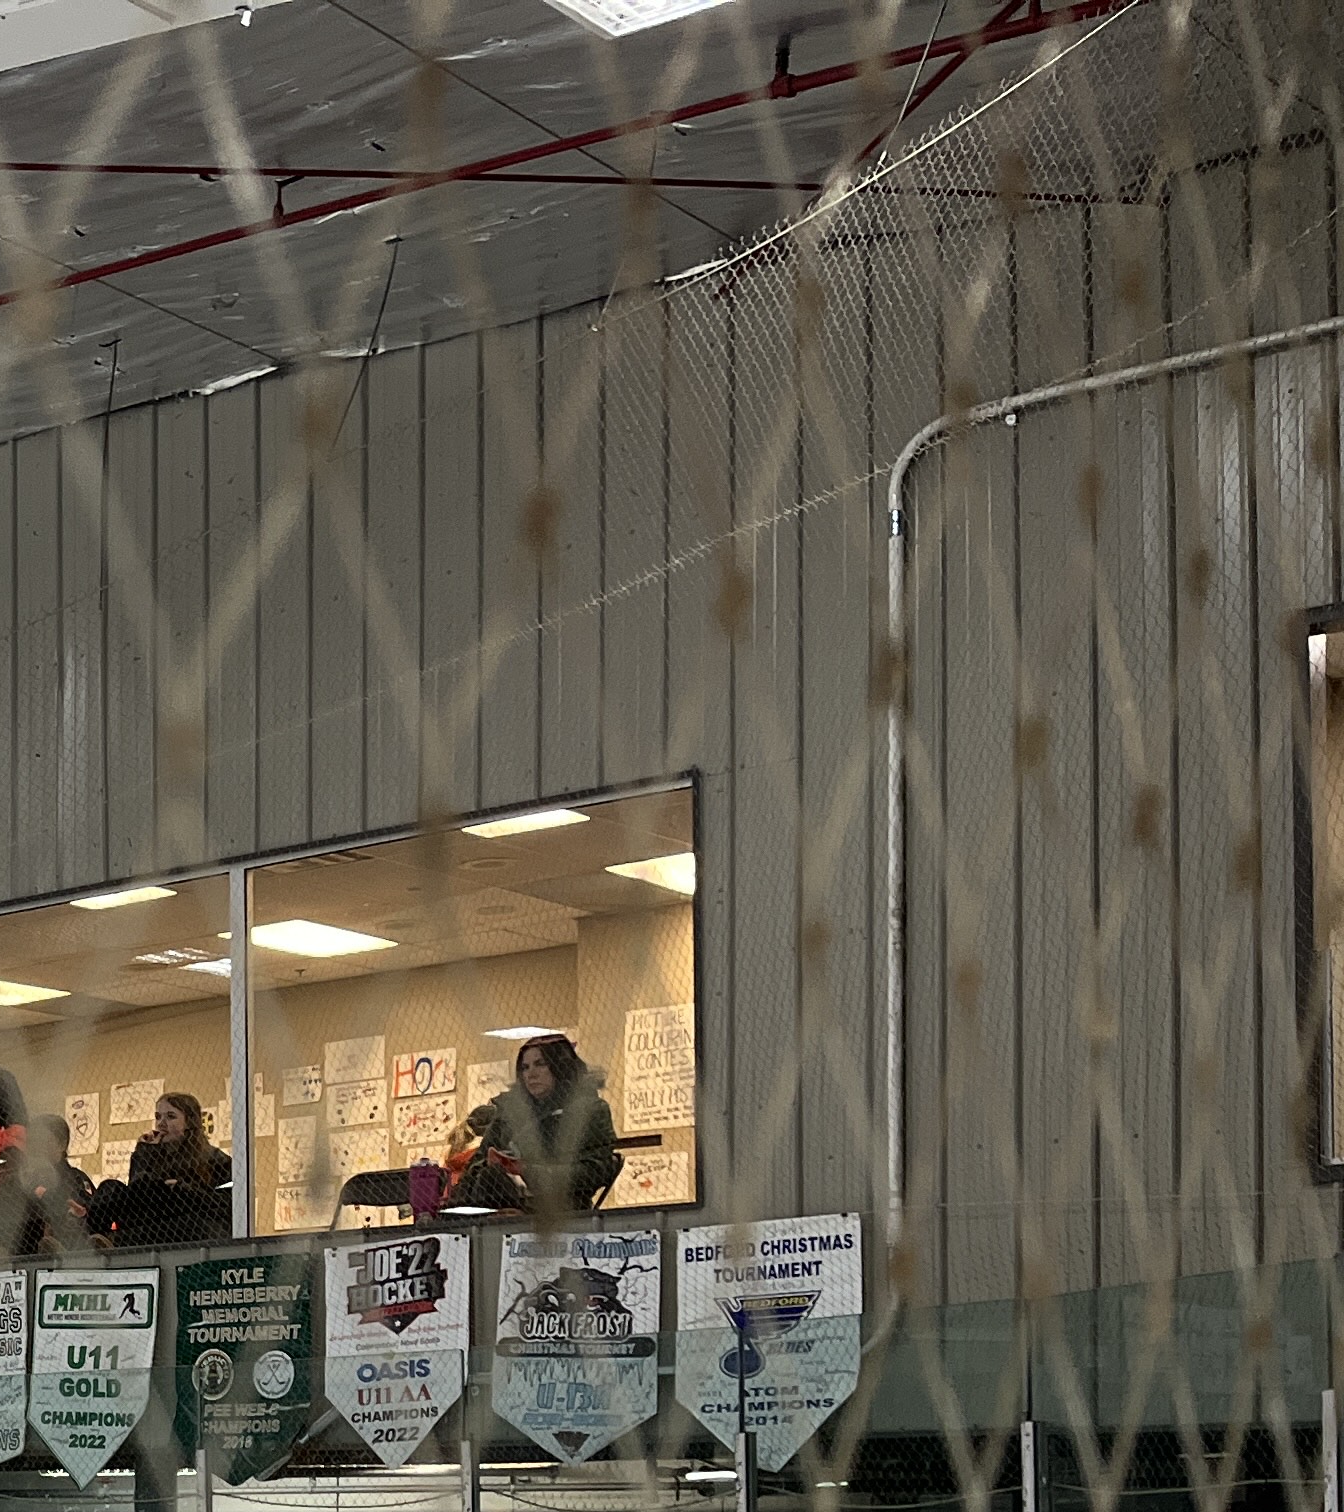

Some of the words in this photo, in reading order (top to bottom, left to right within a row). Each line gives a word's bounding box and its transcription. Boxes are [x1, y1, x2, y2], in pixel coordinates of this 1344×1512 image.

[632, 1008, 686, 1031] PICTRE
[760, 1233, 854, 1256] CHRISTMAS
[221, 1267, 264, 1285] KYLE
[713, 1260, 822, 1283] TOURNAMENT
[53, 1293, 112, 1312] MMHL
[189, 1285, 301, 1307] HENNEBERRY
[742, 1295, 811, 1308] BEDFORD
[202, 1306, 289, 1324] MEMORIAL
[526, 1312, 571, 1336] JACK
[572, 1312, 633, 1337] FROST
[187, 1324, 301, 1344] TOURNAMENT
[67, 1345, 120, 1370] U11
[357, 1359, 431, 1383] OASIS
[59, 1377, 122, 1398] GOLD
[400, 1383, 432, 1401] AA
[40, 1411, 136, 1427] CHAMPIONS
[204, 1403, 233, 1417] PEE
[351, 1406, 439, 1424] CHAMPIONS
[68, 1434, 107, 1449] 2022
[372, 1426, 419, 1444] 2022
